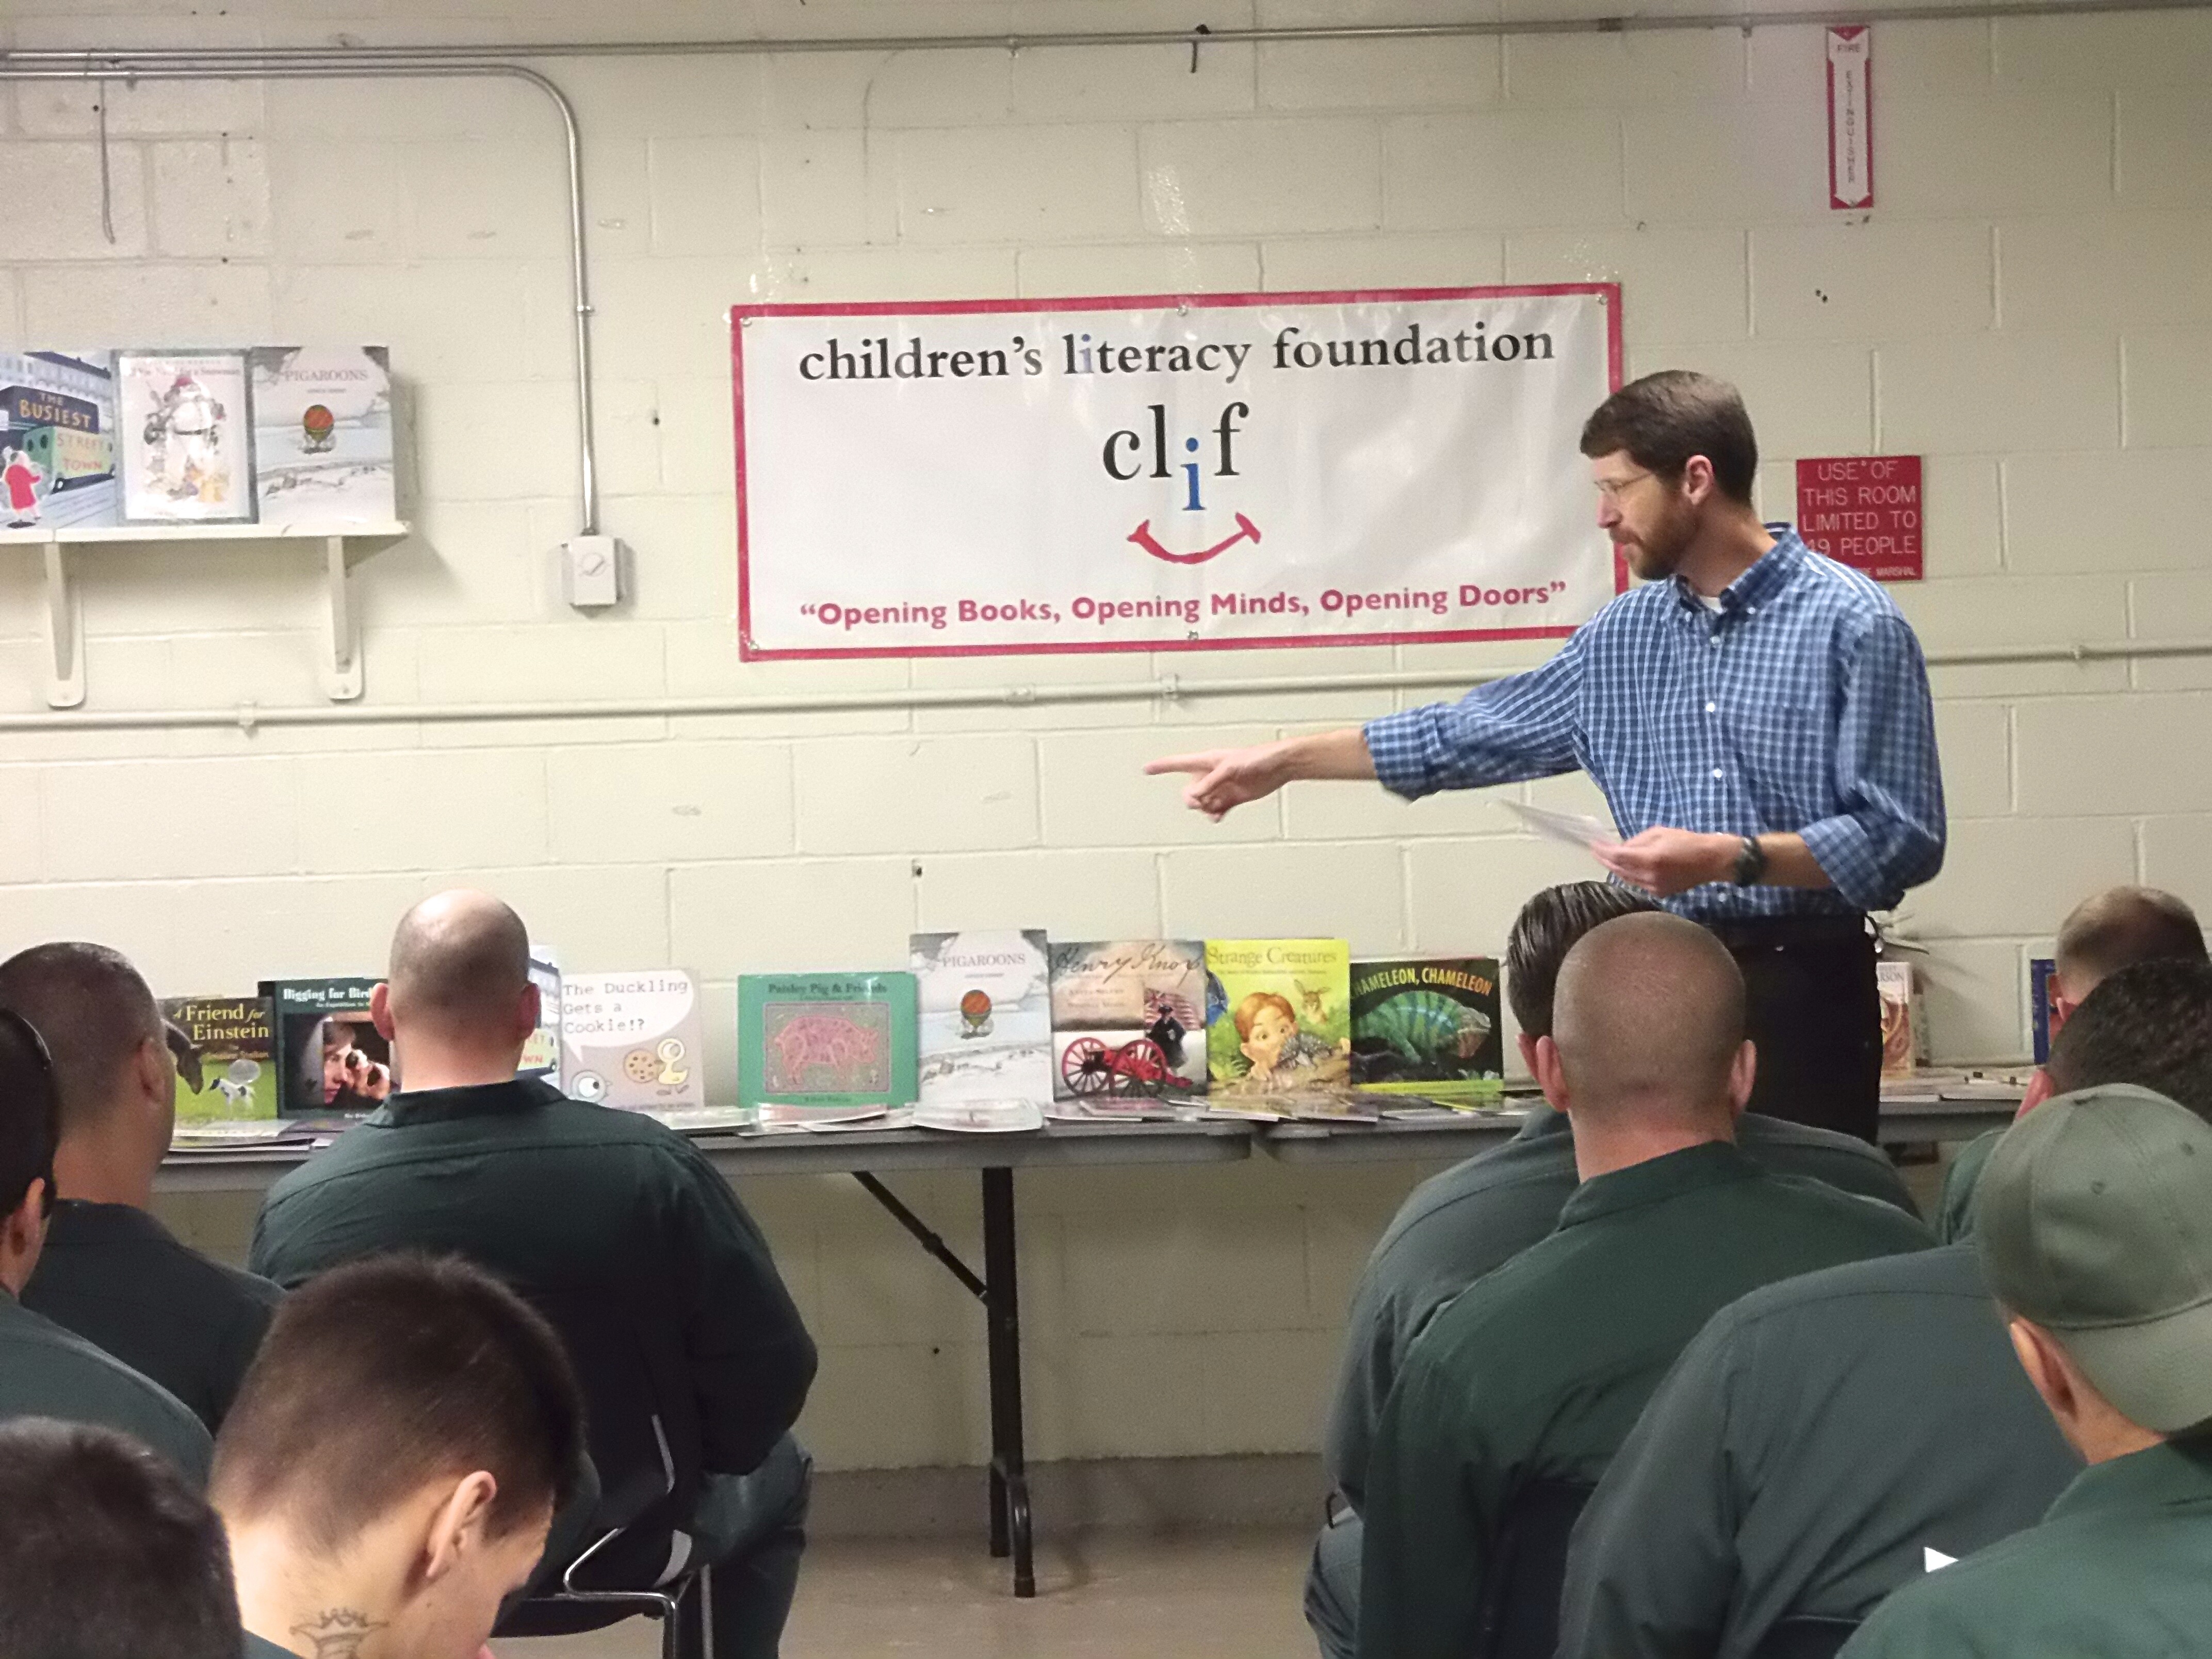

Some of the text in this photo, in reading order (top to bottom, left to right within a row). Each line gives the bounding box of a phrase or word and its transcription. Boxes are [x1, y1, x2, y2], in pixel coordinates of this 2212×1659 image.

[800, 321, 1555, 383] children’s literacy foundation
[284, 369, 368, 381] PIGAROONS
[40, 393, 64, 406] THE
[19, 399, 92, 428] BUSIEST
[63, 458, 103, 470] TOWN
[1102, 401, 1250, 511] clif
[1817, 460, 1898, 481] USE OF
[1803, 485, 1916, 506] THIS ROOM
[1802, 510, 1916, 532] LIMITED TO
[1841, 535, 1916, 556] PEOPLE
[800, 581, 1566, 630] “Opening Books, Opening Minds, Opening Doors”
[942, 954, 1026, 967] PIGAROONS
[1207, 947, 1337, 968] Strange Creatures
[564, 980, 688, 995] The Duckling
[810, 983, 828, 996] Pig
[1421, 967, 1493, 996] CHAMELEON
[329, 987, 345, 999] for
[186, 1003, 243, 1021] Friend
[245, 1009, 266, 1023] for
[564, 1003, 622, 1015] Gets a
[193, 1022, 269, 1040] Einstein
[564, 1018, 645, 1034] Cookie!?
